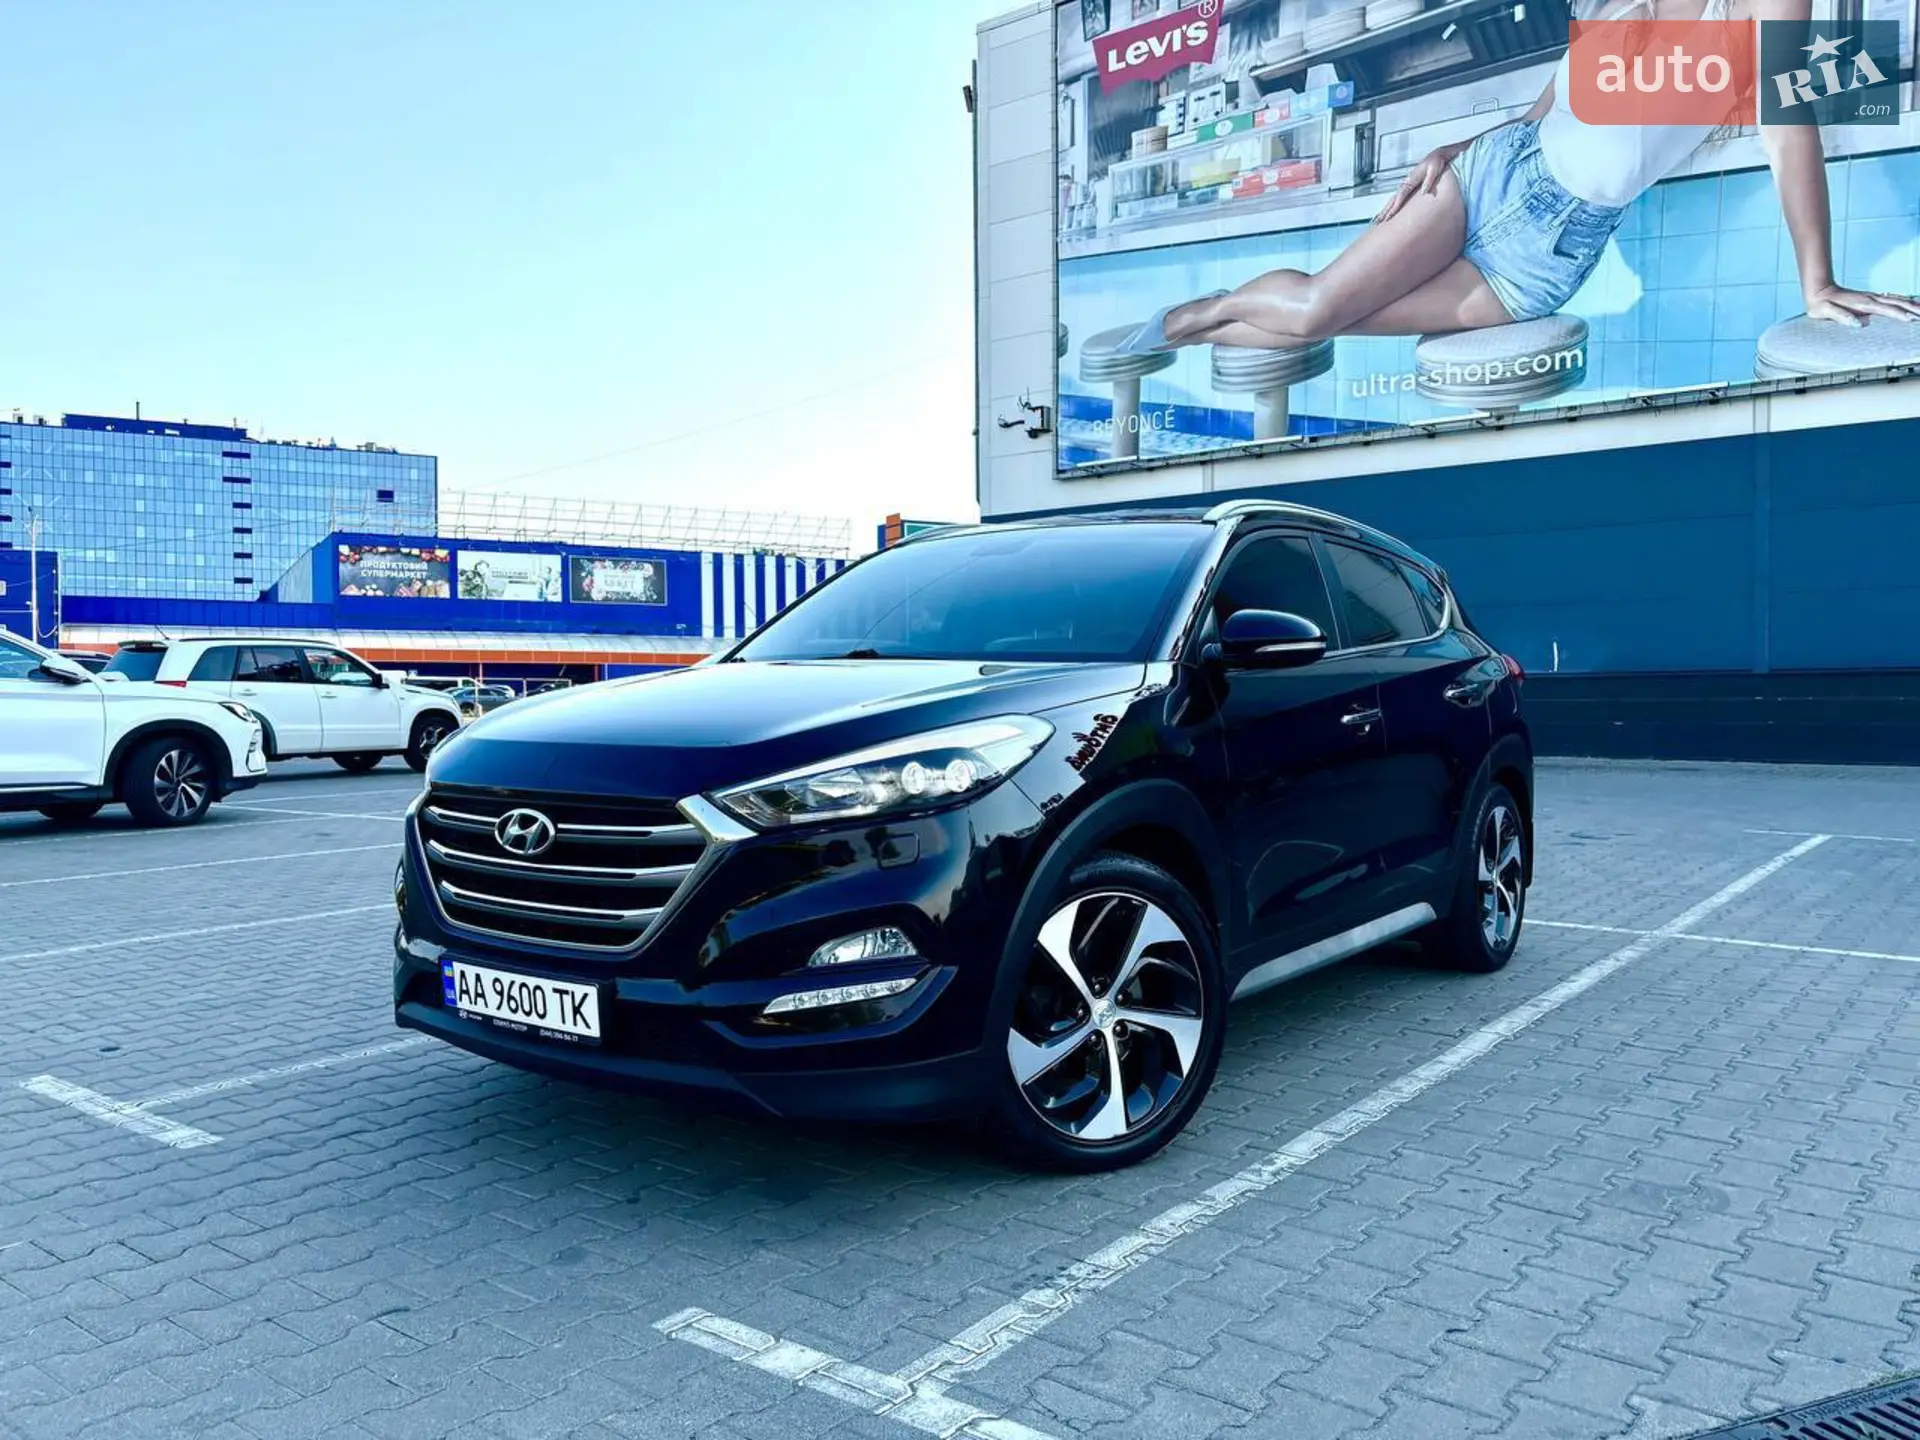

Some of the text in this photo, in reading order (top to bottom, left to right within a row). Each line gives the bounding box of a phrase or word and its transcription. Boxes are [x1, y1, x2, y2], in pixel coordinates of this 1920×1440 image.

[1352, 347, 1584, 398] ultra-shop.com
[361, 569, 427, 579] СУПЕРМАРКЕТ
[458, 969, 591, 1030] AA 9600 TK
